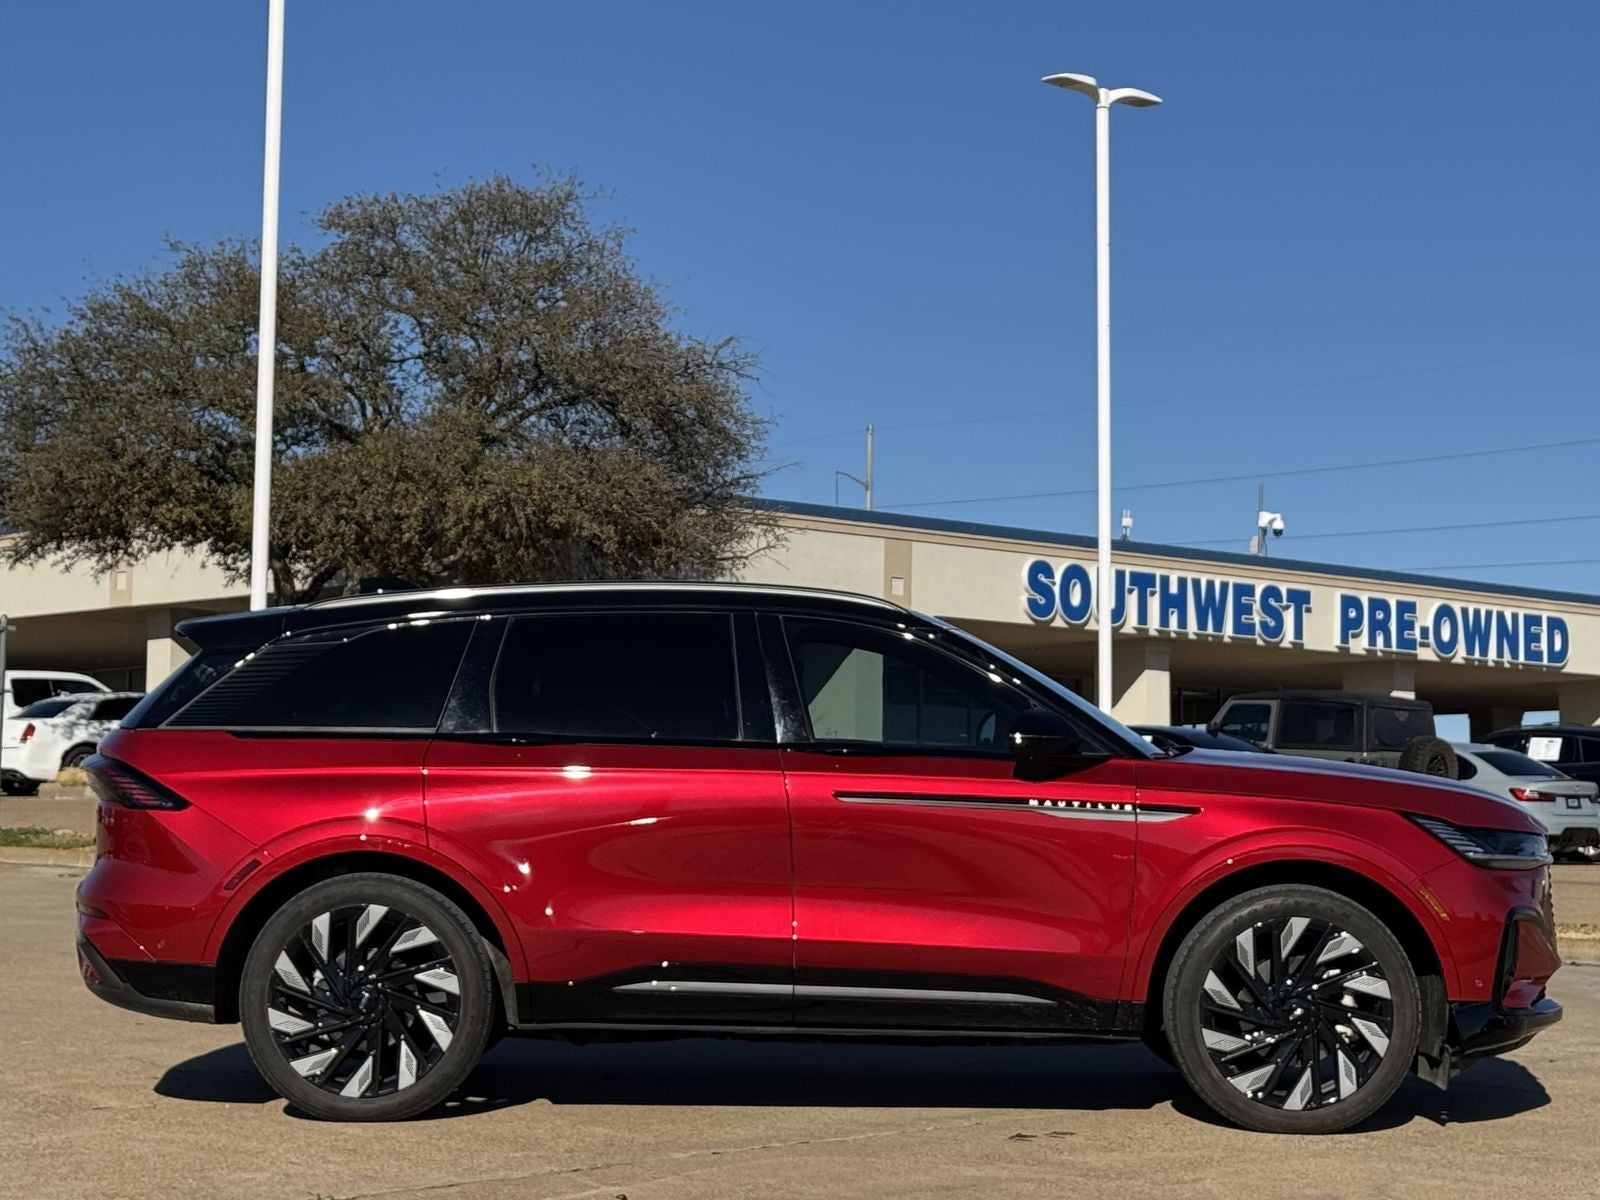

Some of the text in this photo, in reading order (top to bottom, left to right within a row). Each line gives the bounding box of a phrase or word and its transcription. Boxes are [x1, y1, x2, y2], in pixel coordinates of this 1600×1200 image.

[1026, 559, 1569, 667] SOUTHWEST PRE-OWNED
[1029, 799, 1133, 811] NAUTILUS
